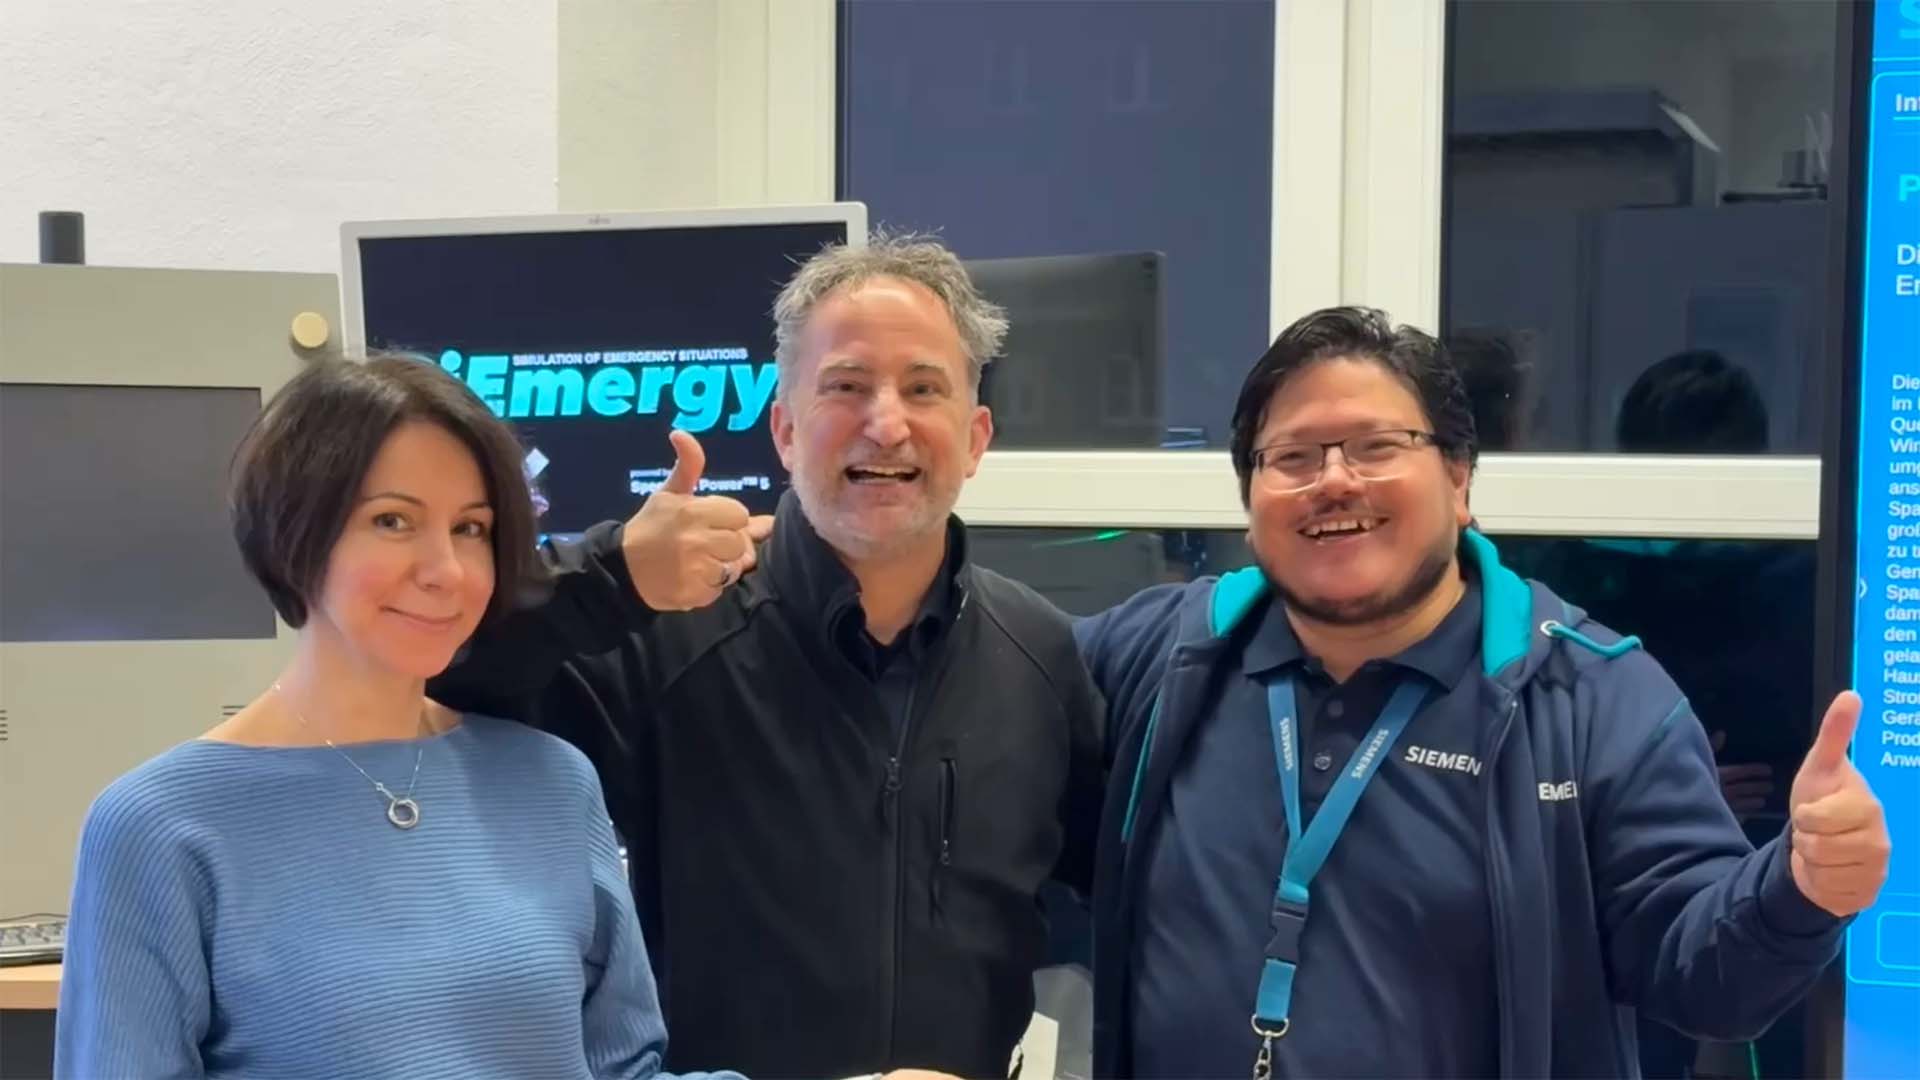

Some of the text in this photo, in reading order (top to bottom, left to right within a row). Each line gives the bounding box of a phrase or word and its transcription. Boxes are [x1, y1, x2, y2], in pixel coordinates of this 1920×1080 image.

[1895, 93, 1920, 112] In
[512, 347, 748, 366] SIMULATION OF EMERGENCY SITUATIONS
[1279, 717, 1293, 772] SIEMENS
[1351, 728, 1390, 779] SIEMENS
